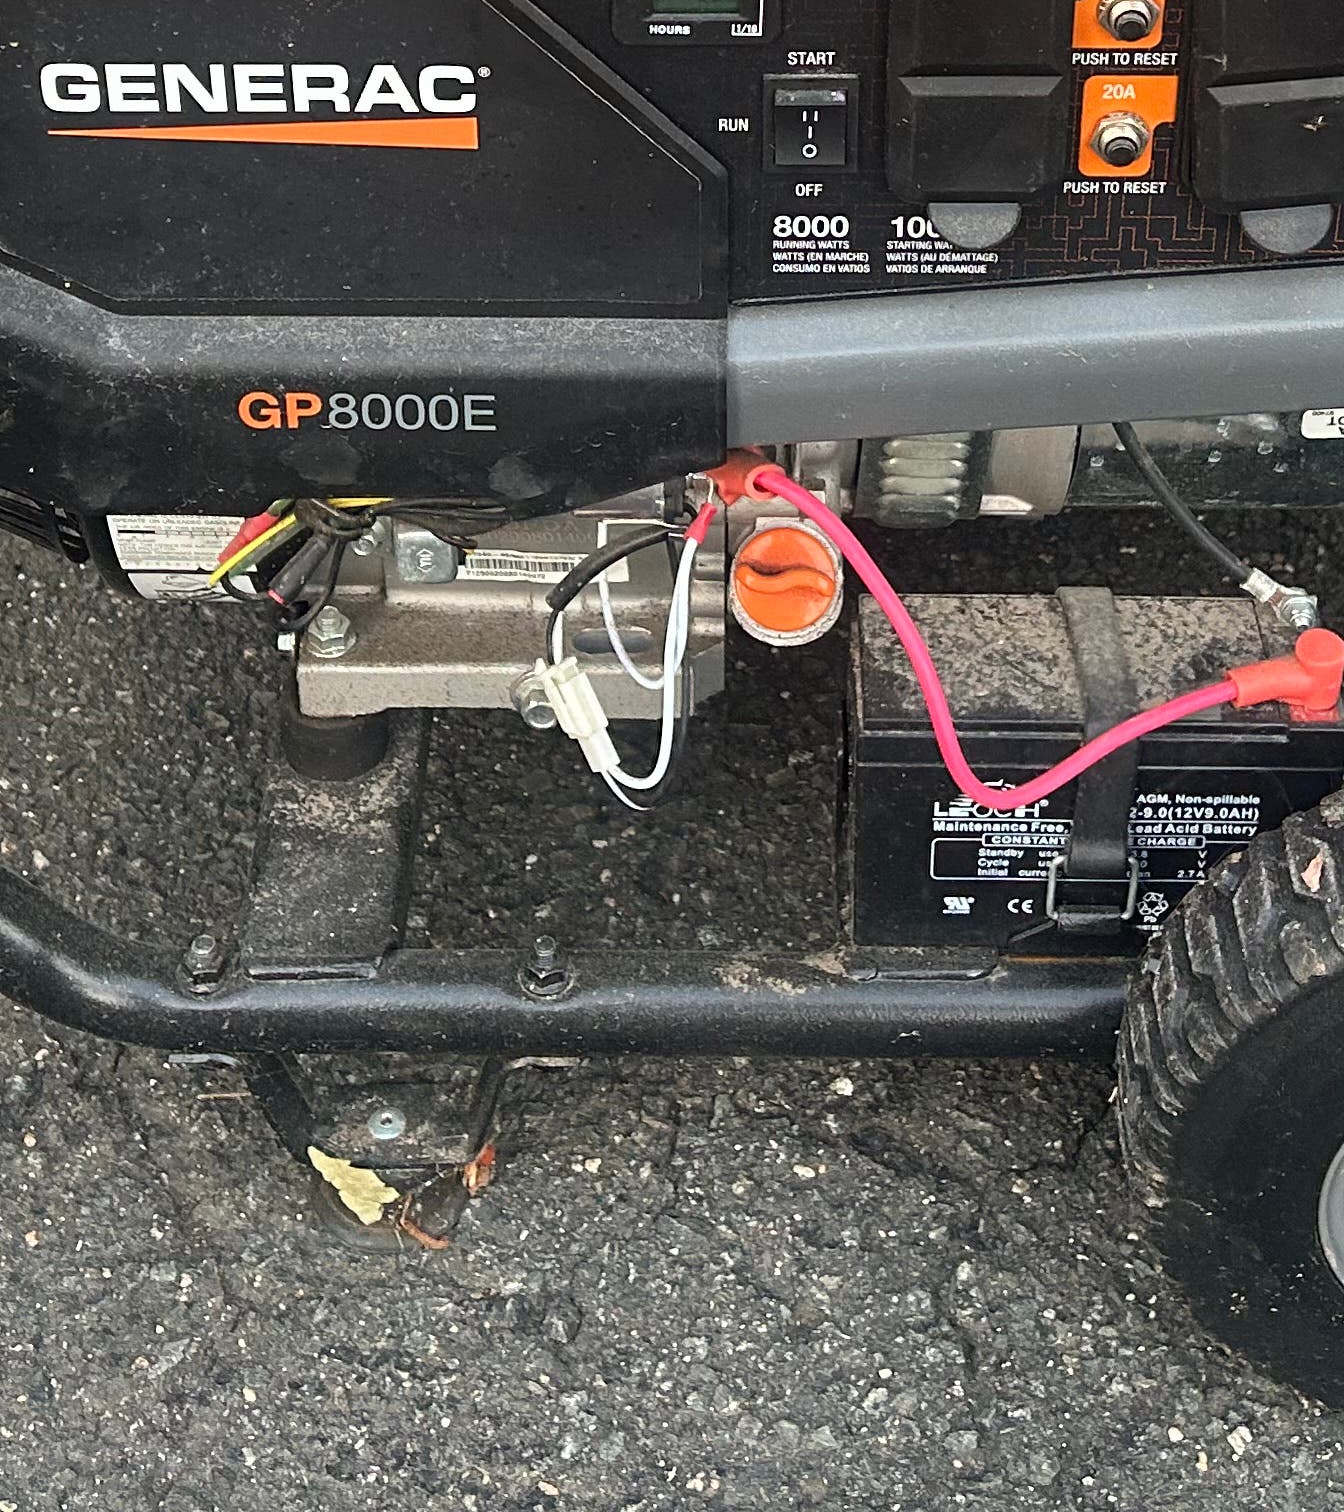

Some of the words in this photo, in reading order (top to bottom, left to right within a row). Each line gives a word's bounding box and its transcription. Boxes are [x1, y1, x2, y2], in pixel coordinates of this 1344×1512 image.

[649, 23, 691, 35] HOURS
[787, 51, 836, 66] START
[1071, 52, 1108, 67] PUSH
[1112, 52, 1131, 67] TO
[1134, 52, 1178, 67] RESET
[40, 62, 478, 114] GENERAC
[1102, 84, 1135, 101] 20A
[718, 117, 749, 132] RUN
[795, 183, 824, 197] OFF
[1063, 181, 1099, 195] PUSH
[1103, 181, 1122, 195] TO
[1124, 181, 1167, 195] RESET
[772, 215, 850, 238] 8000
[772, 240, 816, 250] RUNNING
[817, 240, 850, 250] WATTS
[886, 240, 933, 250] STARTING
[772, 252, 805, 262] WATTS
[806, 252, 823, 263] (EN
[825, 252, 869, 262] MARCHE)
[886, 252, 919, 262] WATTS
[920, 252, 937, 263] (AU
[772, 264, 821, 273] CONSUMO
[823, 264, 836, 273] EN
[837, 264, 871, 273] VATIOS
[886, 264, 919, 274] VATIOS
[920, 264, 934, 274] DE
[934, 264, 988, 274] ARRANQUE
[237, 391, 498, 432] GP8000E
[1136, 793, 1172, 805] AGM,
[1175, 794, 1261, 806] Non-spillable
[1129, 806, 1260, 821] 2-9.0(12V9.0AH)
[933, 820, 1028, 832] Maintenance
[1030, 821, 1069, 834] Free,
[1127, 823, 1162, 834] Lead
[1164, 823, 1199, 835] Acid
[1202, 824, 1258, 837] Battery
[991, 835, 1066, 845] CONSTANT
[1137, 837, 1197, 846] CHARGE
[978, 848, 1025, 859] Standby
[1197, 850, 1208, 859] V
[977, 858, 1010, 868] Cycle
[1197, 860, 1207, 869] V
[977, 868, 1009, 877] Initial
[1018, 869, 1048, 878] curre
